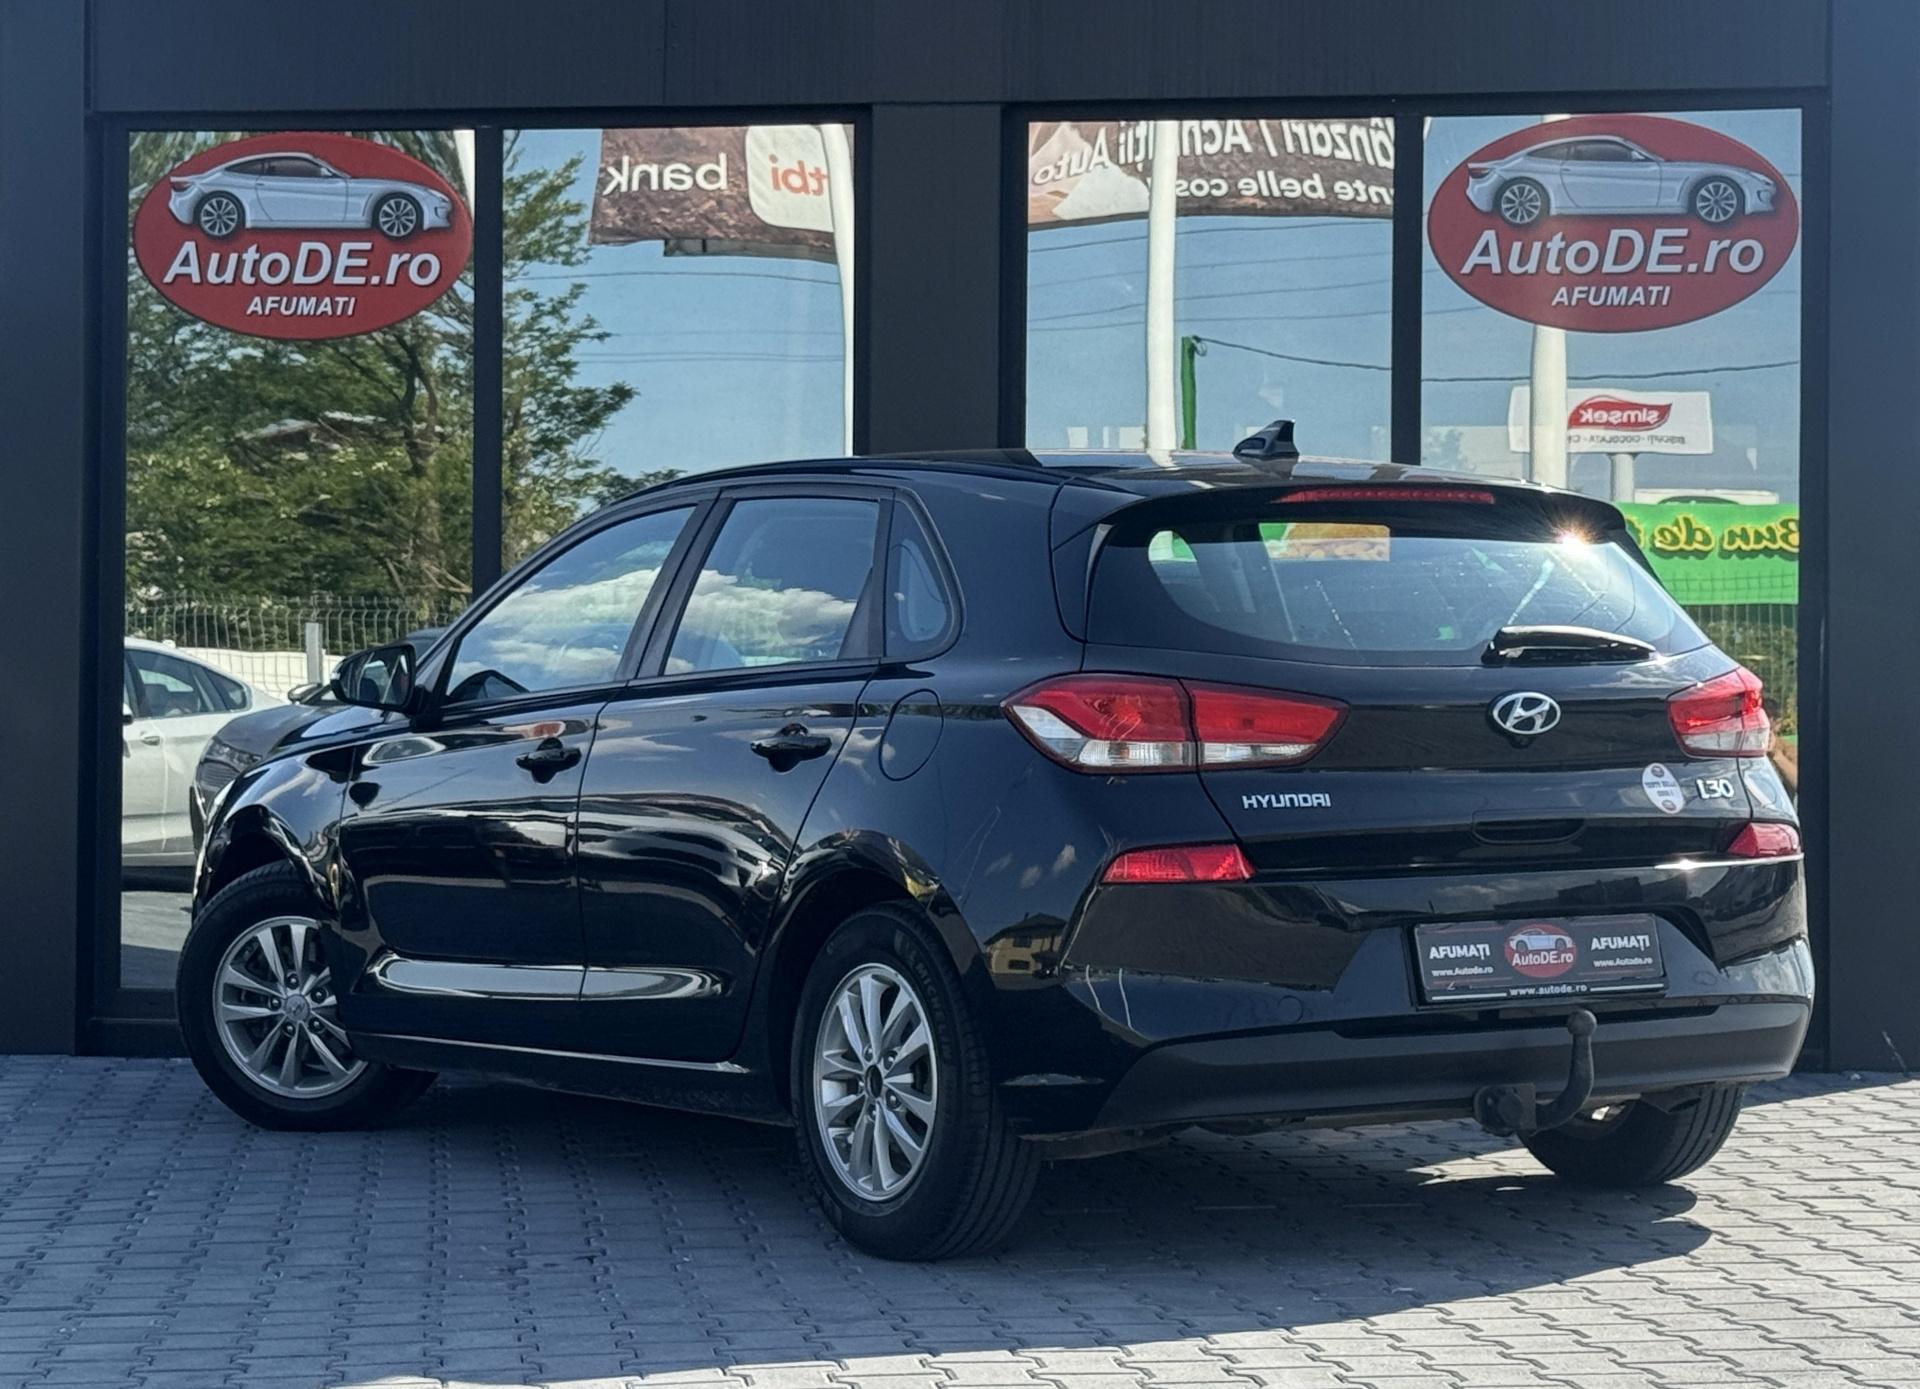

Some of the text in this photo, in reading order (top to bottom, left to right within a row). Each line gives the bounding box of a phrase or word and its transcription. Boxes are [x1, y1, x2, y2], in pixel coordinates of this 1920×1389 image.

[1460, 227, 1766, 276] AutoDE.ro
[163, 241, 441, 287] AutoDE.ro
[1242, 793, 1332, 809] HYUNDAI
[1512, 950, 1574, 967] AutoDE.ro
[1509, 984, 1588, 997] www.autode.ro
